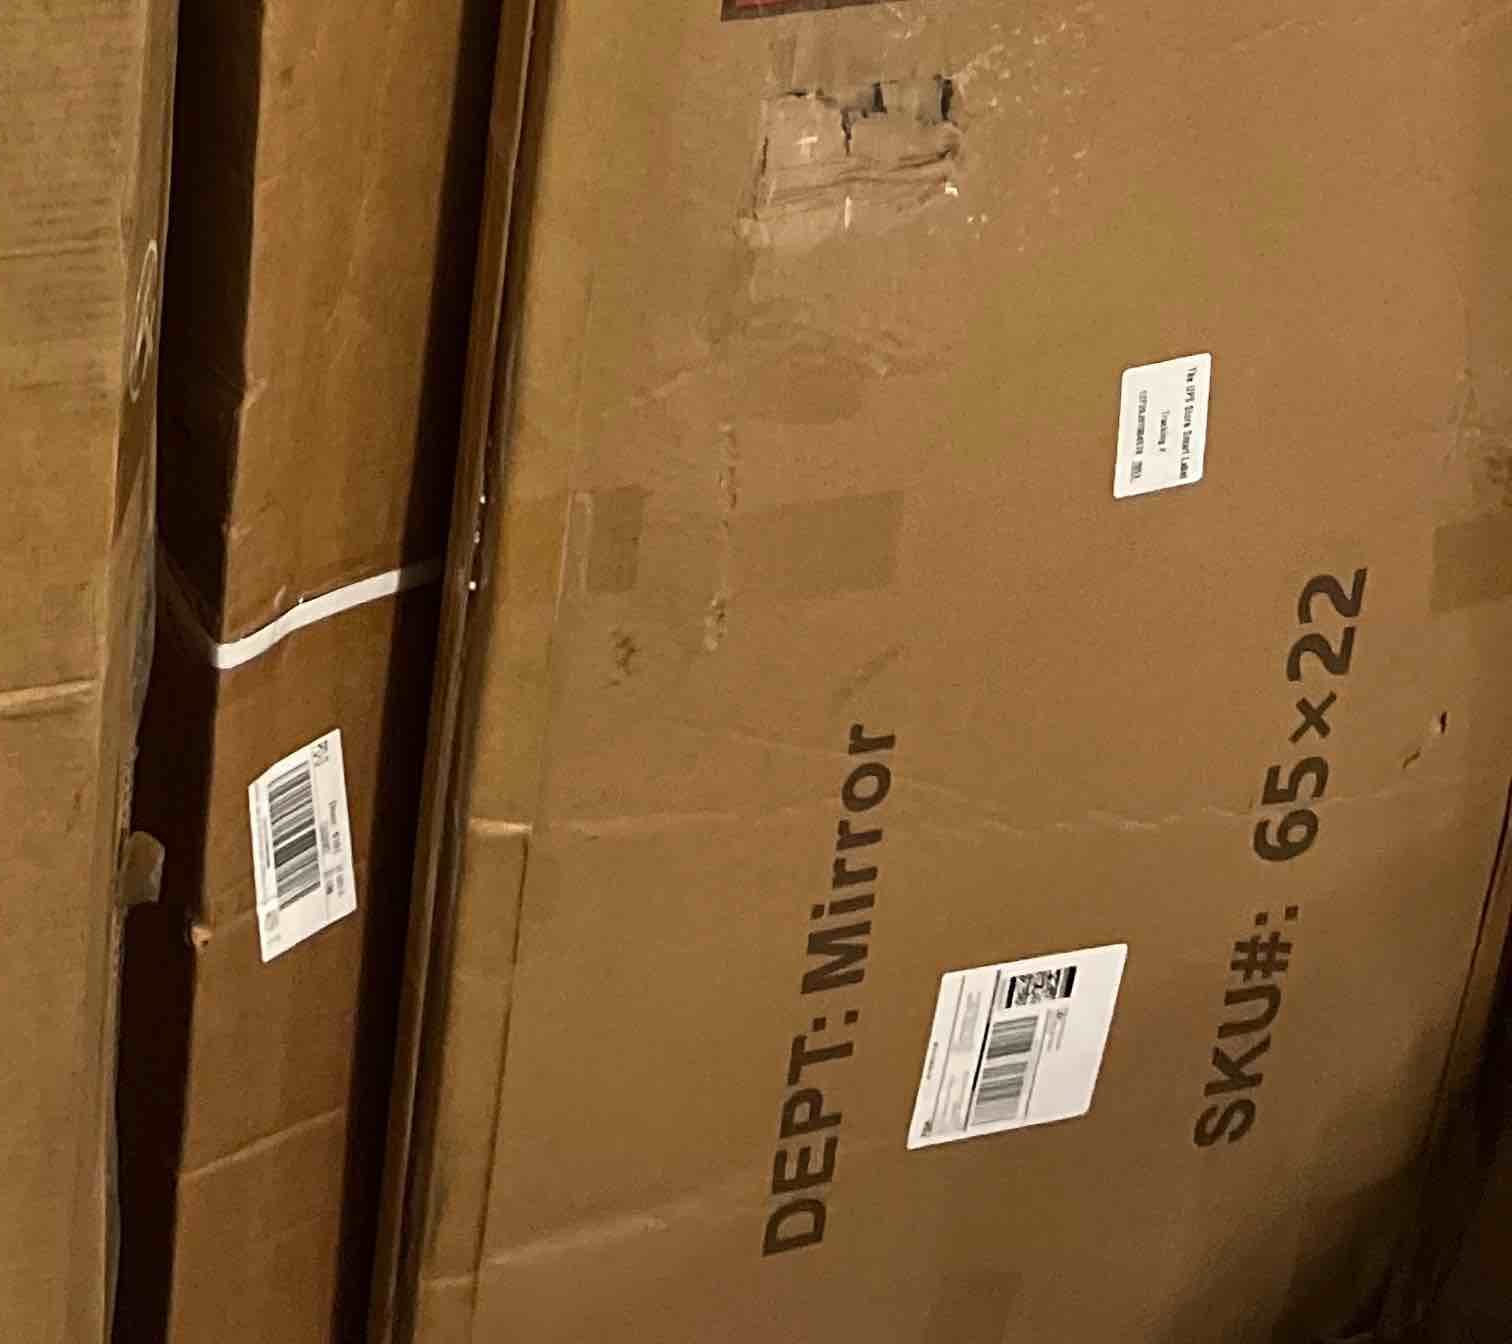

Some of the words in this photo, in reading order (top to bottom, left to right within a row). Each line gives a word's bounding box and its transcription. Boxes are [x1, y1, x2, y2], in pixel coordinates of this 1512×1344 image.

[800, 723, 896, 995] Mirror
[762, 1009, 860, 1258] DEPT:
[1193, 904, 1300, 1149] SKU#:
